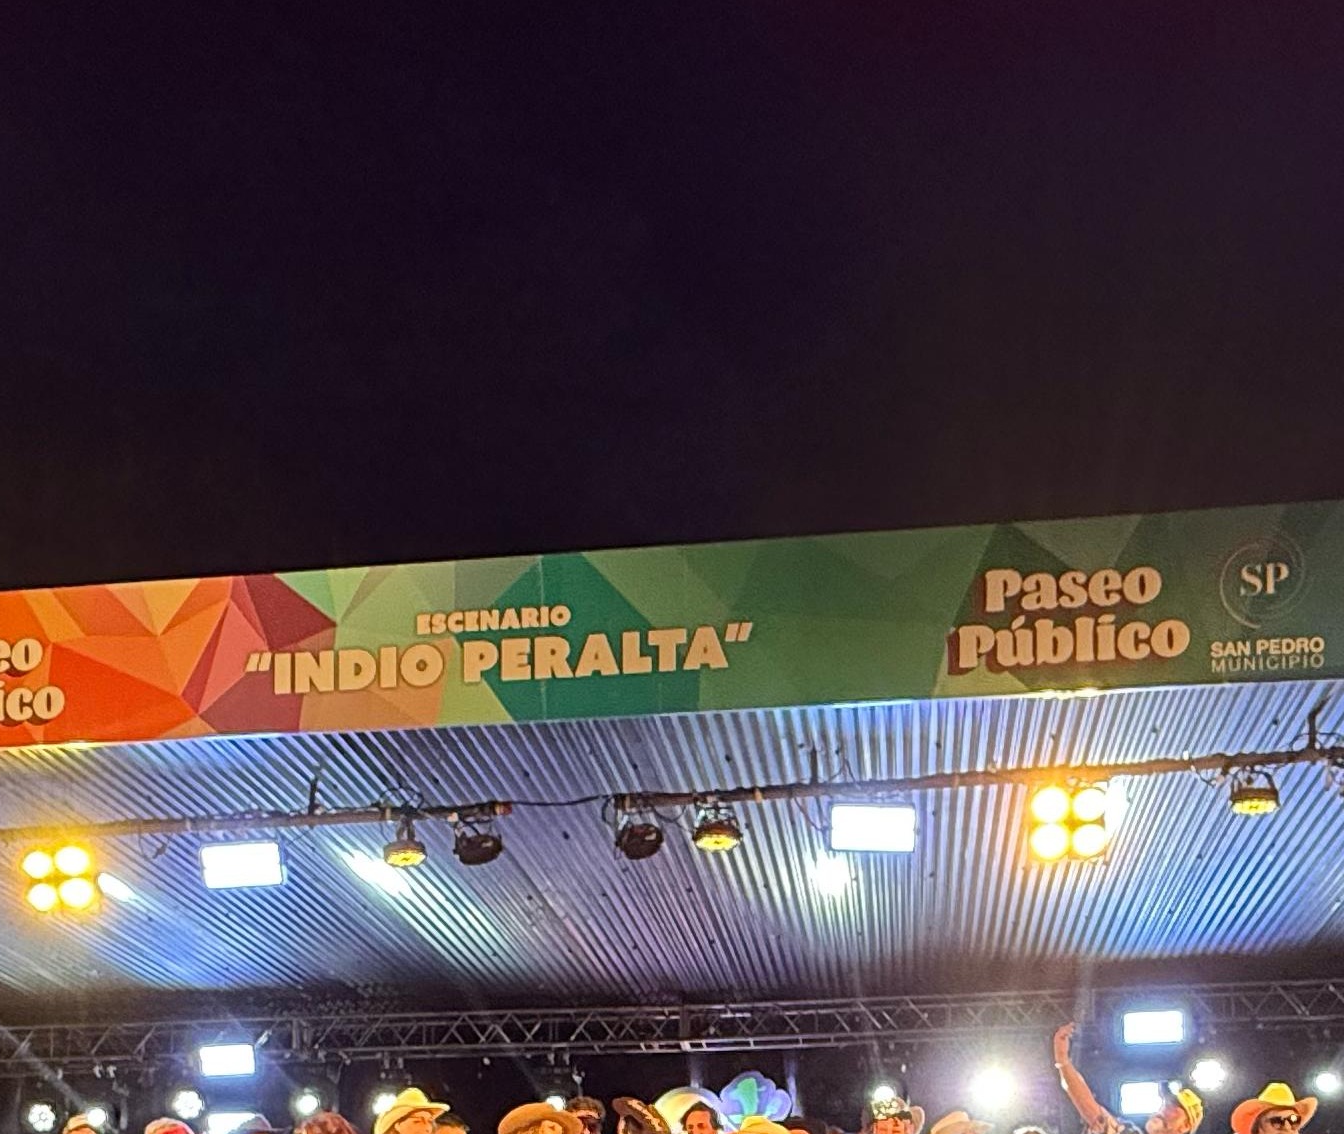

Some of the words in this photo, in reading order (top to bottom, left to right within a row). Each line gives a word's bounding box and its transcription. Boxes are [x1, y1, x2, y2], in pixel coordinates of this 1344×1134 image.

[984, 565, 1163, 613] Paseo
[1239, 561, 1290, 596] SP
[416, 605, 572, 636] ESCENARIO
[956, 613, 1192, 669] Público
[1210, 640, 1251, 658] SAN
[1256, 636, 1325, 656] PEDRO
[1211, 653, 1325, 673] MUNICIPIO
